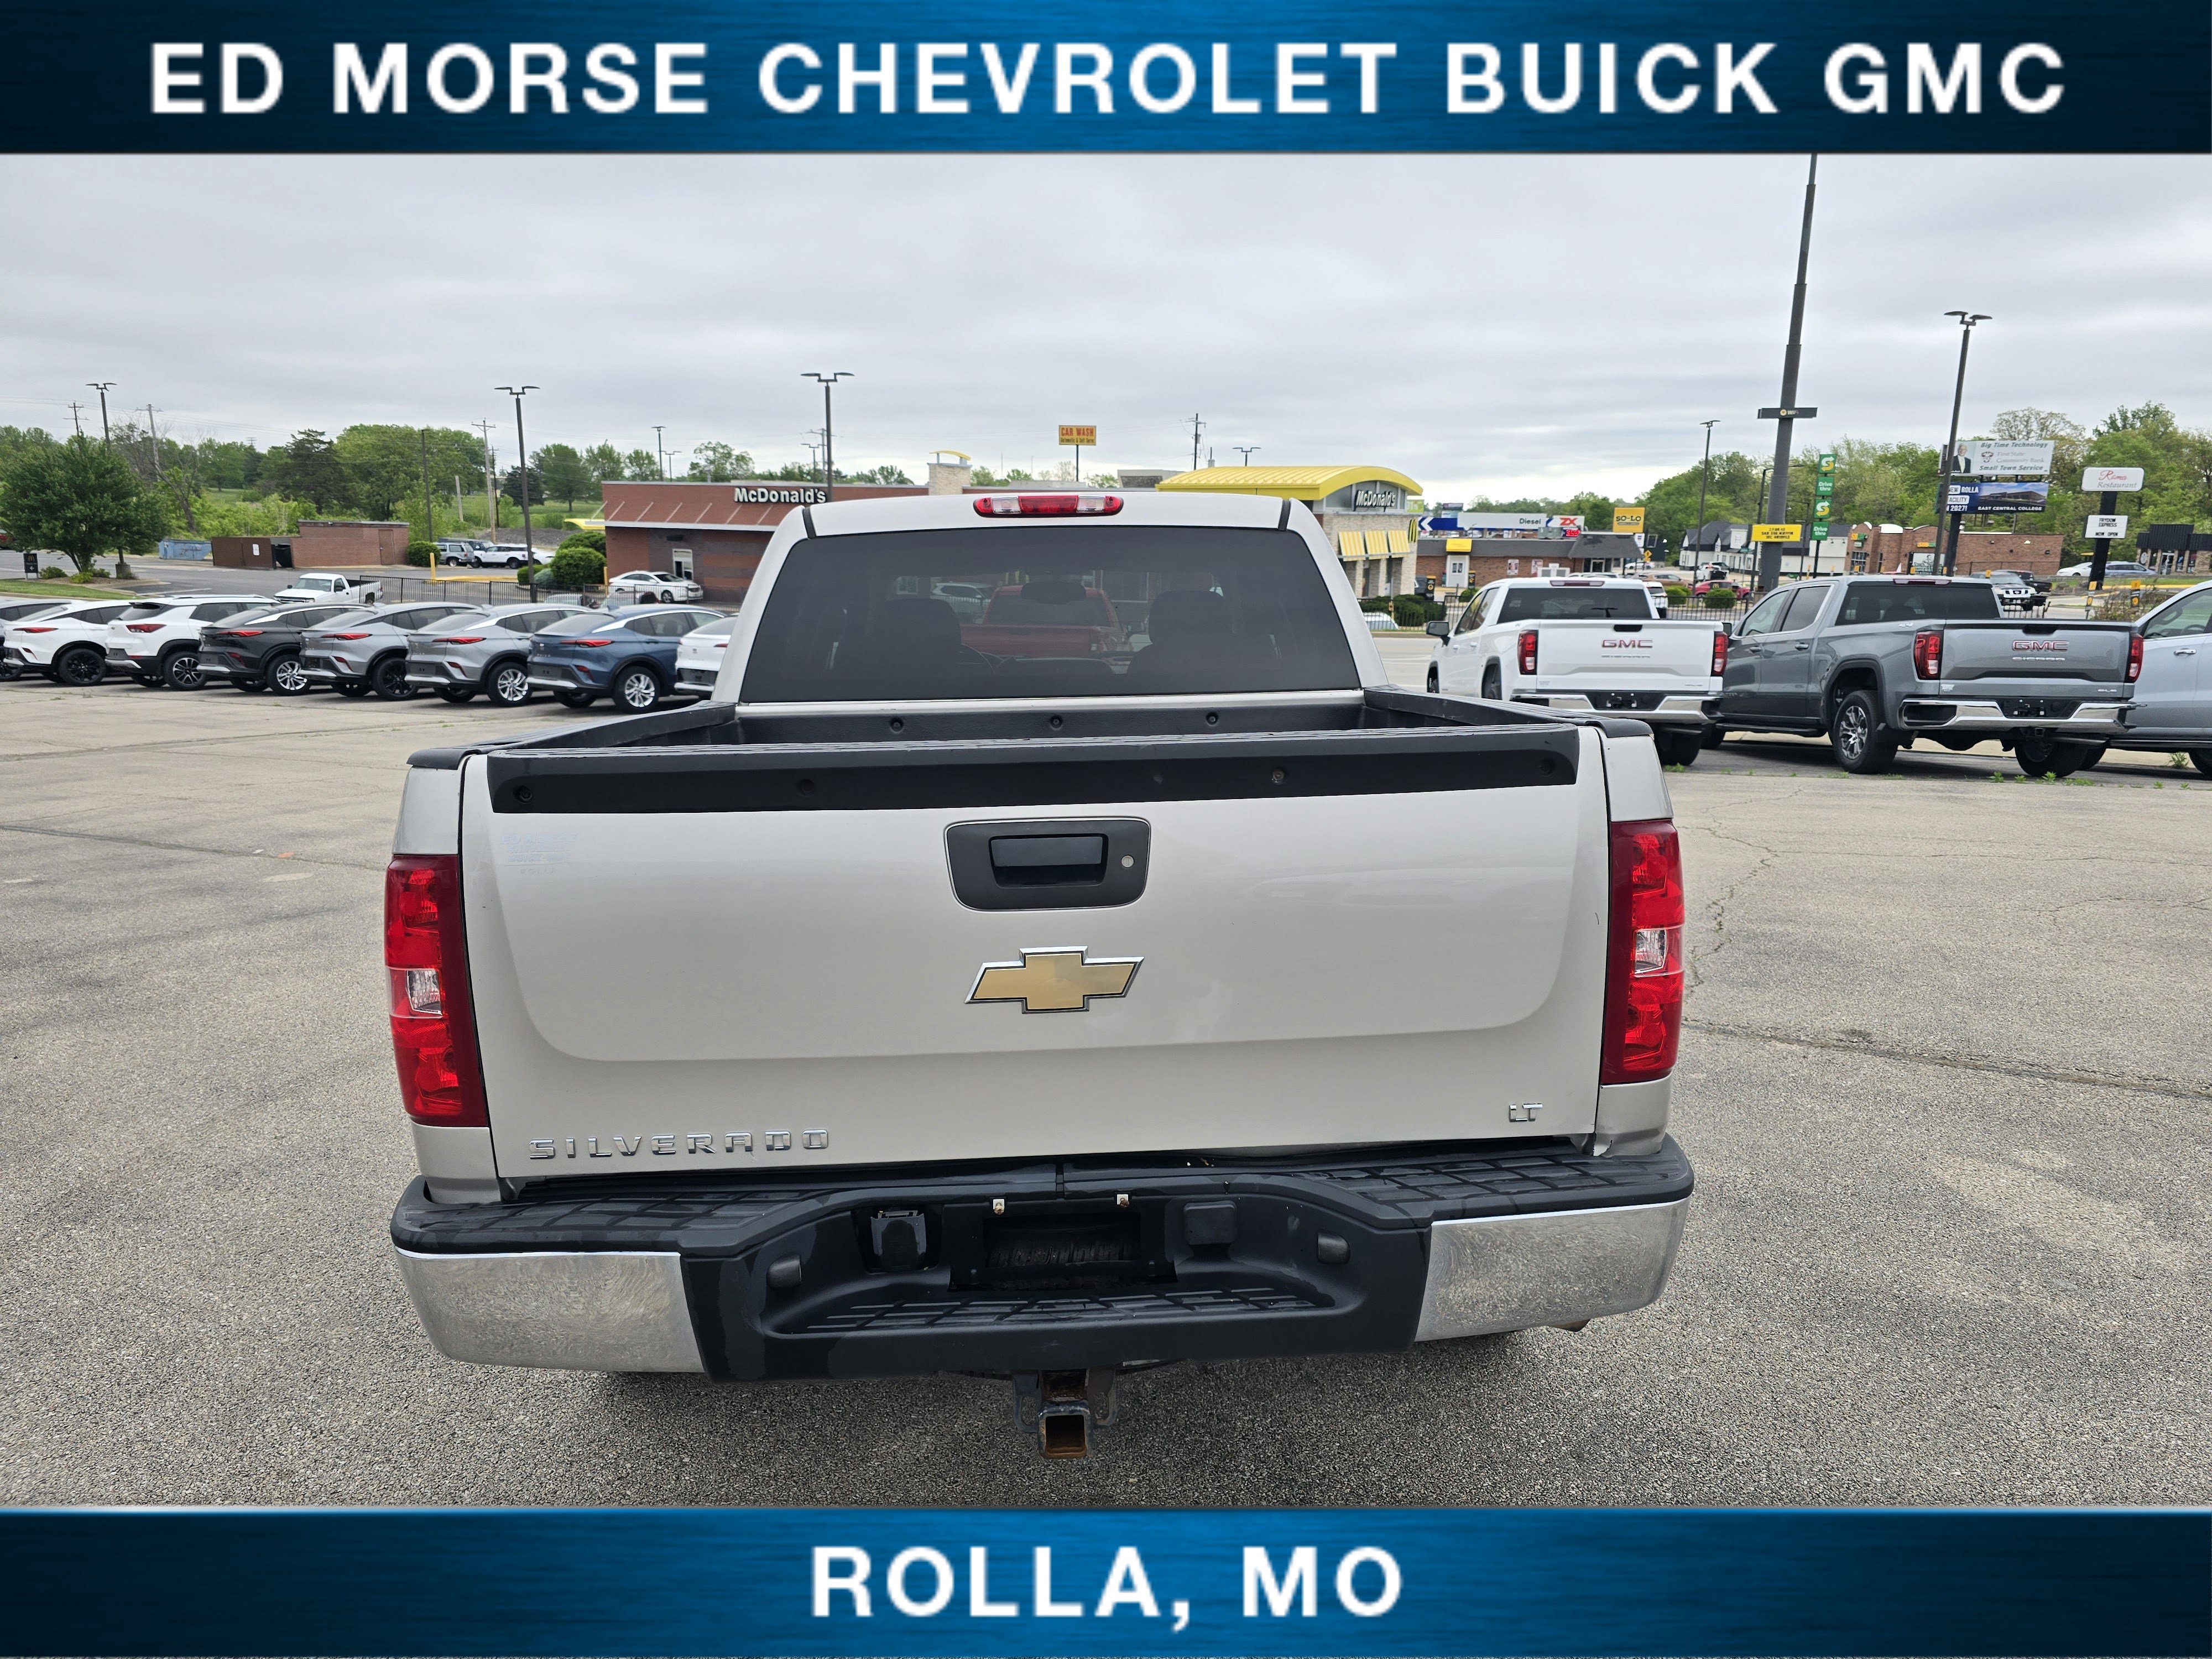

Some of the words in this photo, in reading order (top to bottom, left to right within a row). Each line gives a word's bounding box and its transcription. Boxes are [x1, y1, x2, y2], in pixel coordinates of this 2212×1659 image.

[1061, 427, 1073, 436] CAR
[1076, 427, 1094, 437] WASH
[734, 487, 826, 503] McDonald's
[1355, 490, 1396, 507] McDonald's
[1601, 639, 1653, 649] GMC
[2012, 640, 2069, 652] GMC
[1509, 1103, 1543, 1123] LT
[528, 1129, 830, 1160] SILVERADO
